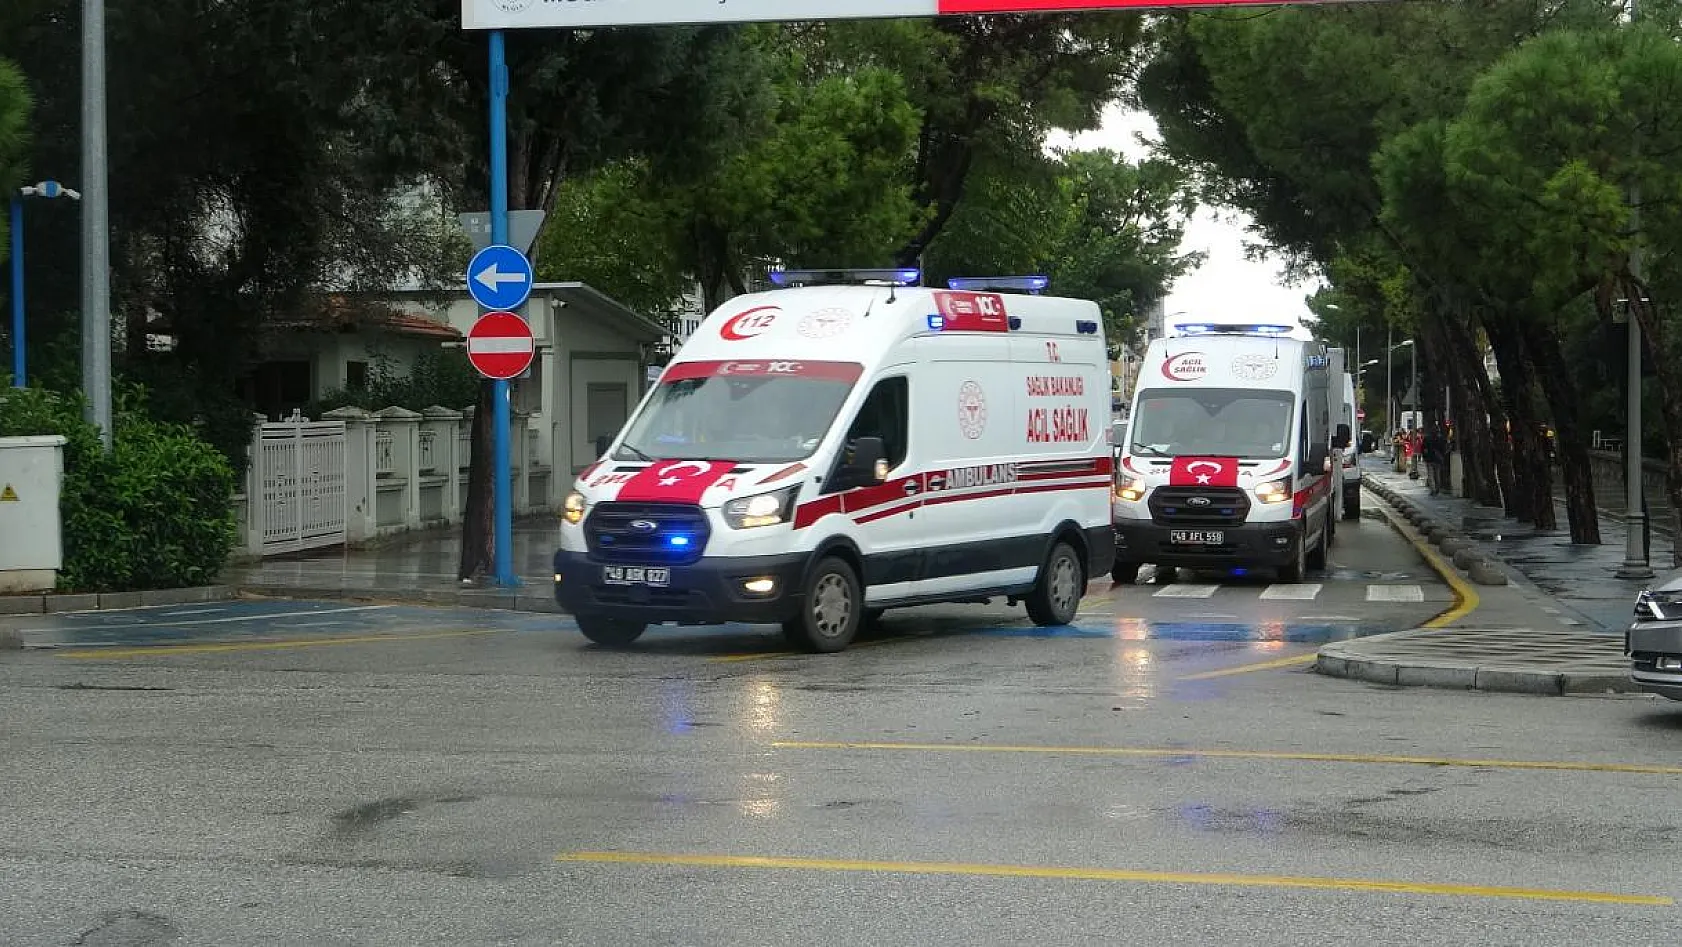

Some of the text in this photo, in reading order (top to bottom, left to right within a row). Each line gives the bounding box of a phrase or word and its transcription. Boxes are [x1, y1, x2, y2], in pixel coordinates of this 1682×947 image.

[740, 315, 775, 329] 112
[1052, 404, 1089, 442] SAĞLIK
[945, 463, 1016, 490] AMBULANS
